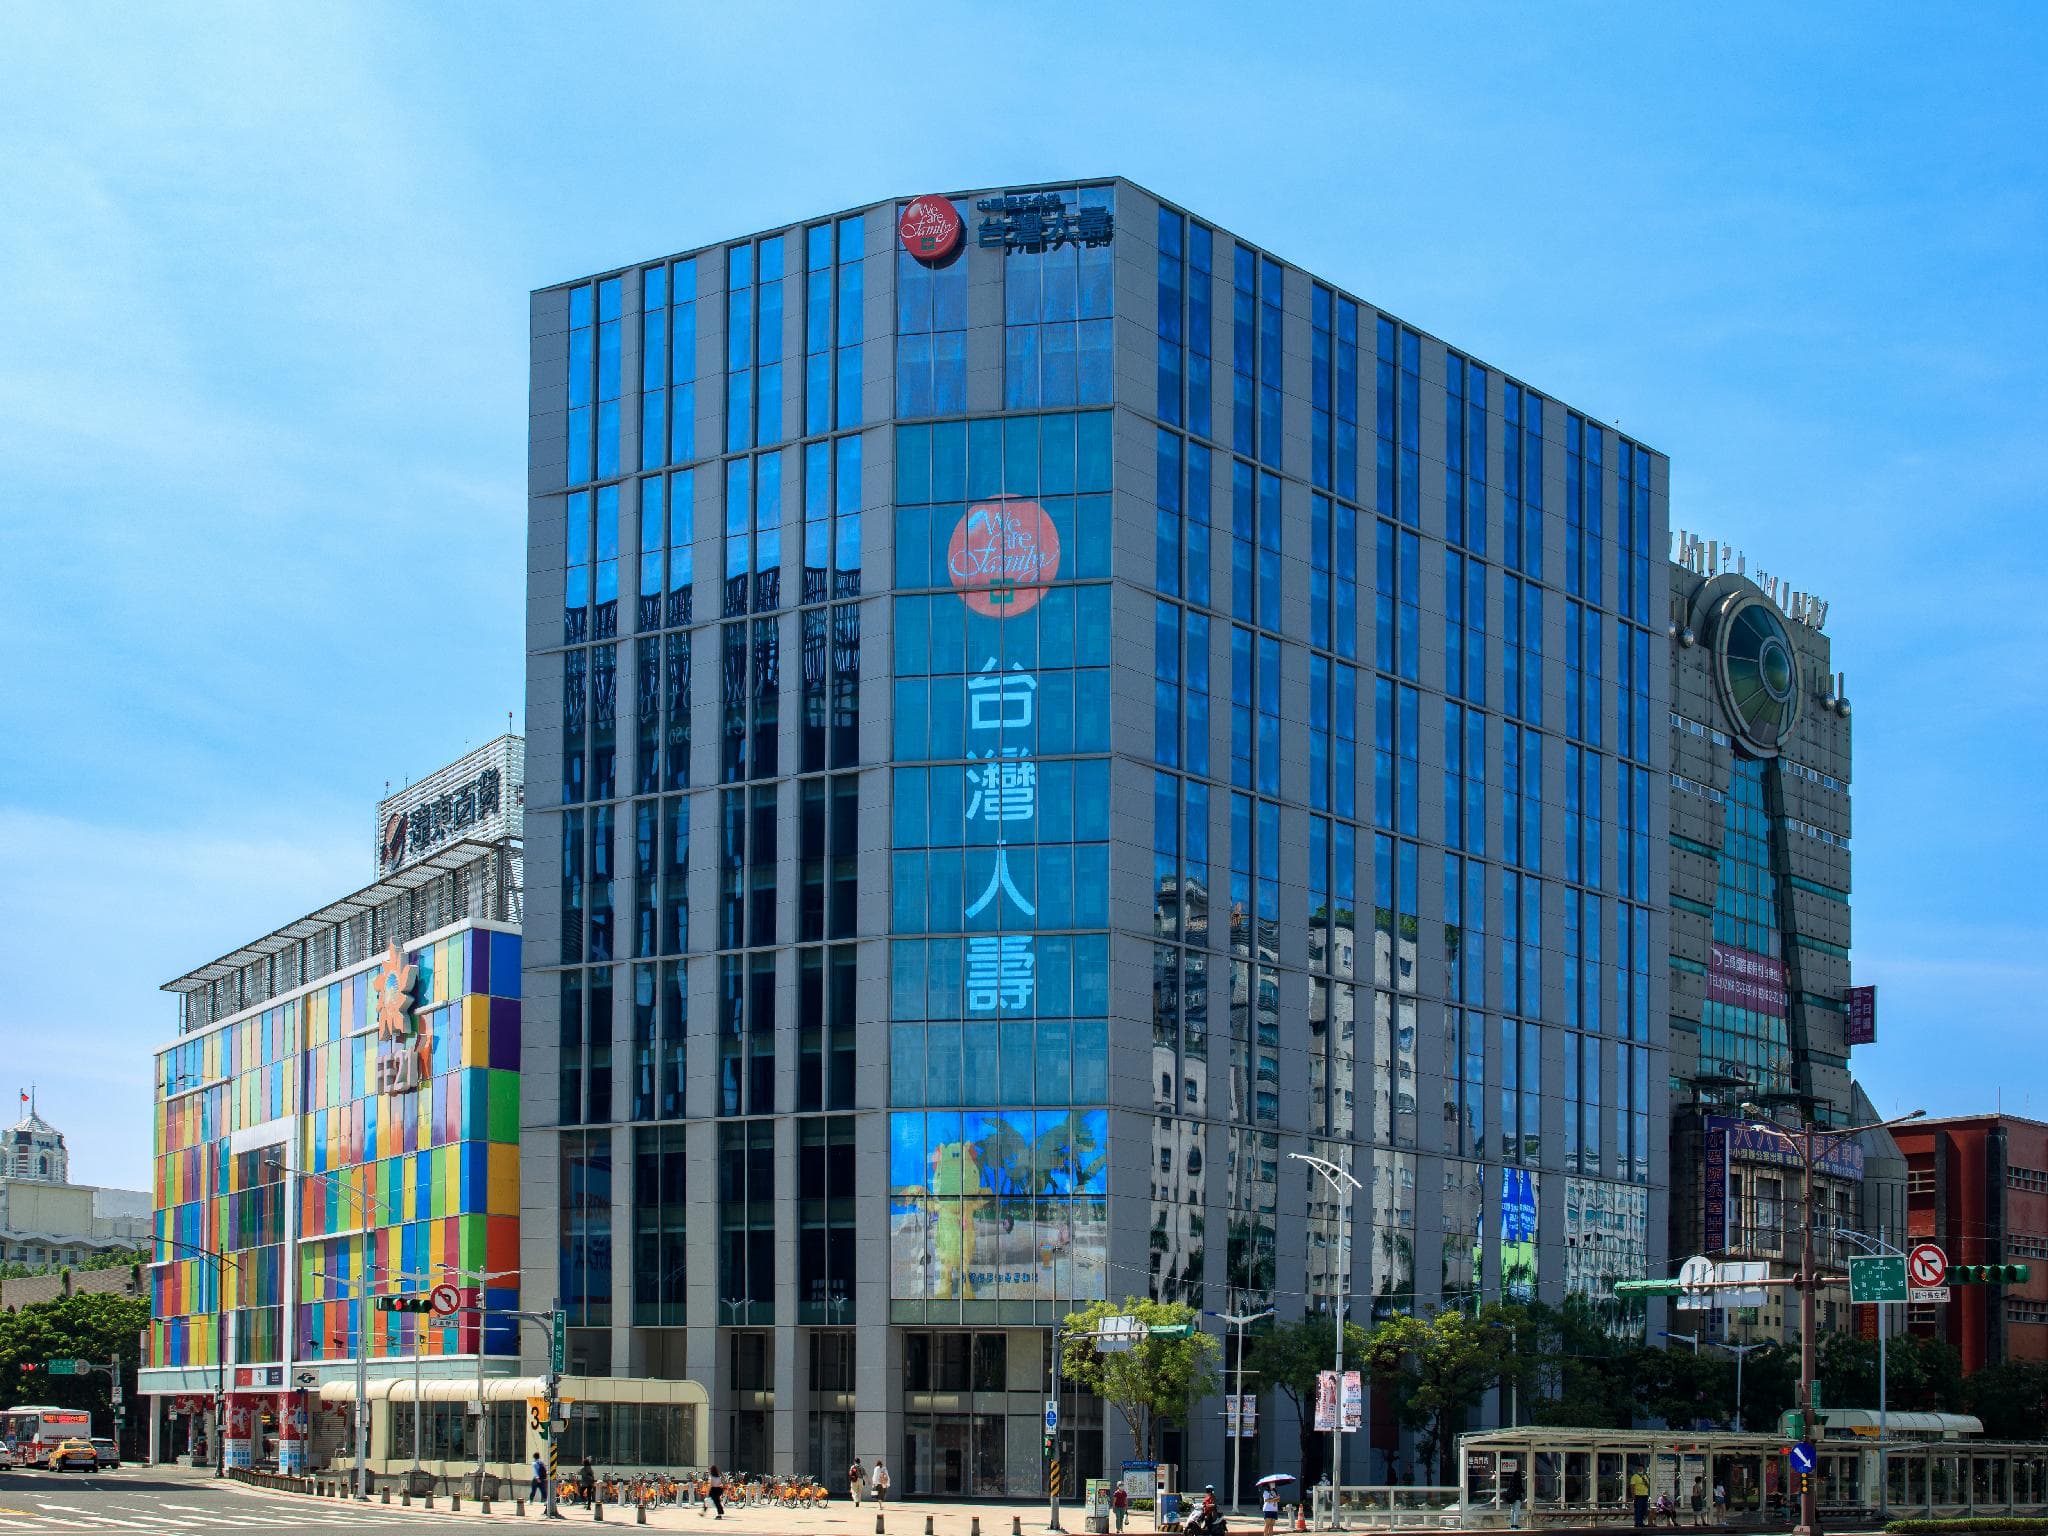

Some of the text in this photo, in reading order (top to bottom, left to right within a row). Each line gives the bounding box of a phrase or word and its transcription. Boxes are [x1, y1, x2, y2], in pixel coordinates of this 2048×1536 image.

[964, 656, 1037, 1011] 台灣人壽
[531, 1406, 540, 1430] 3
